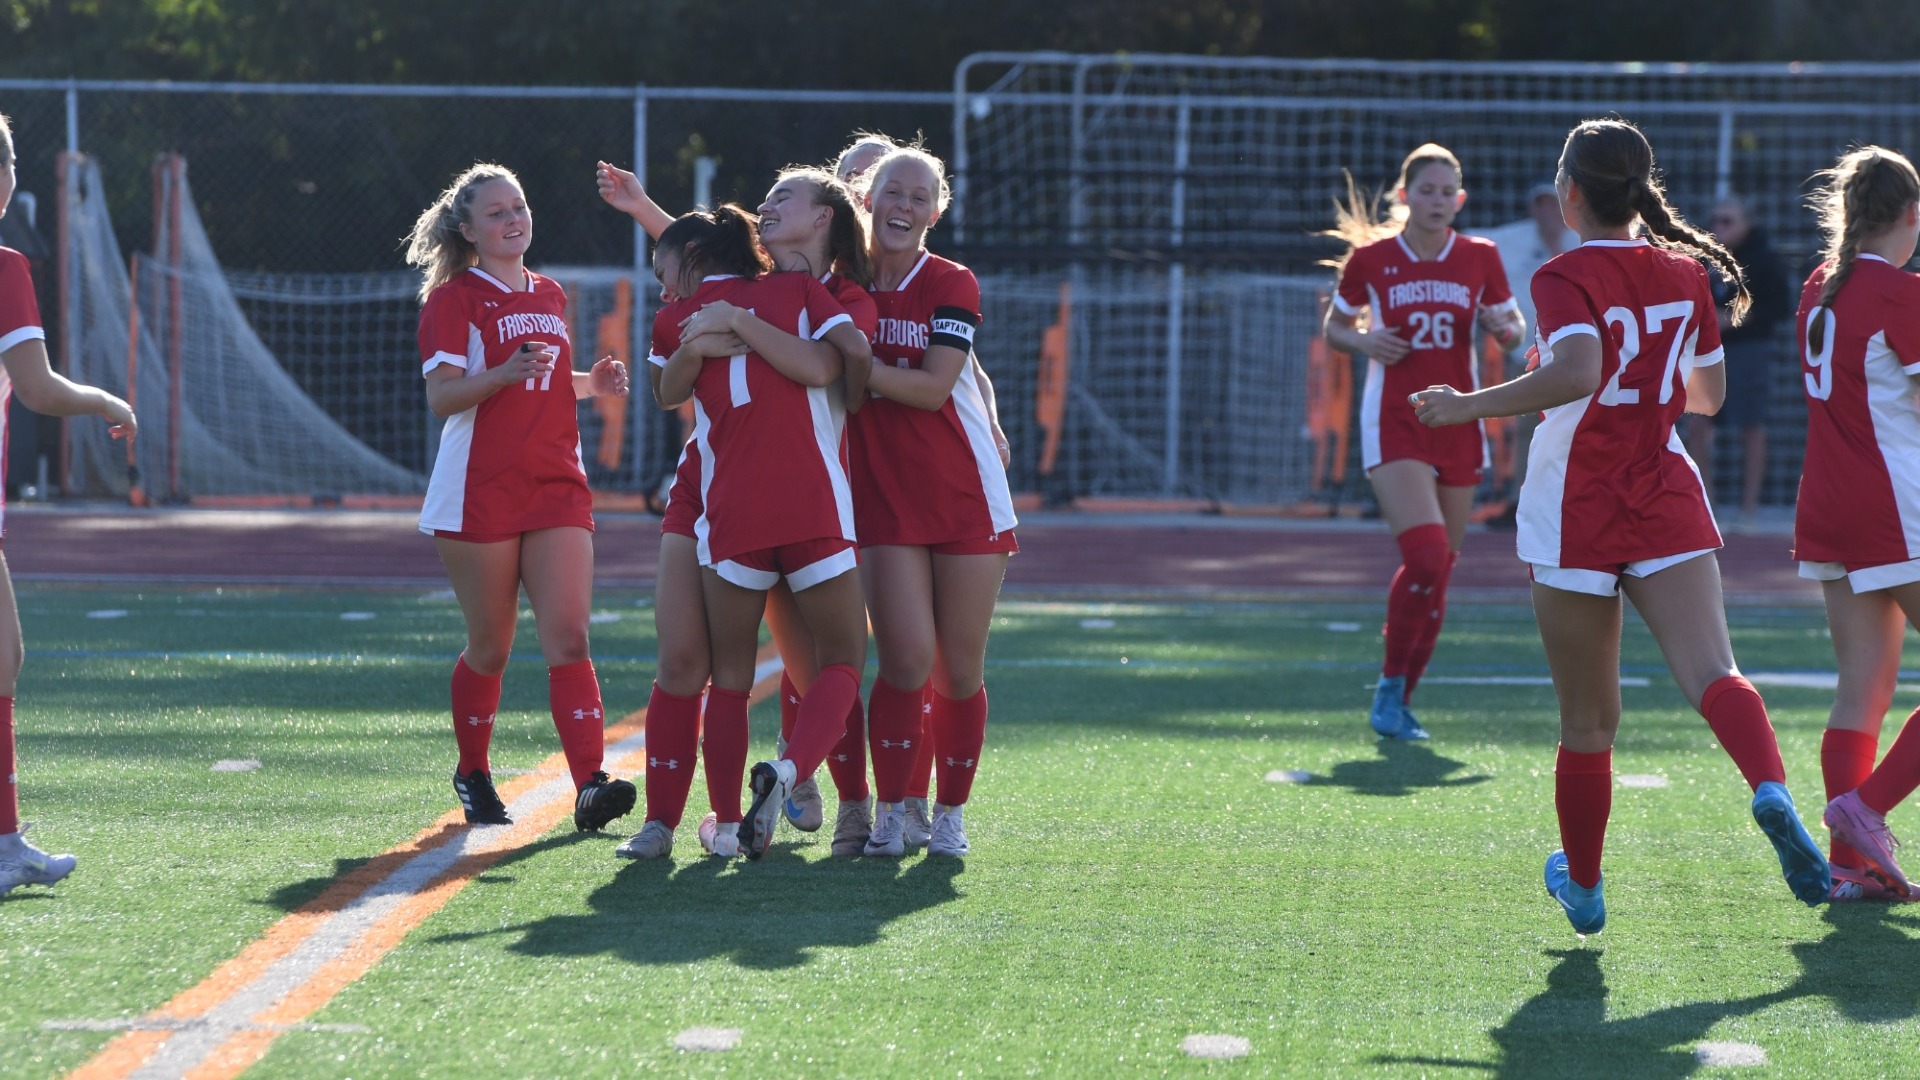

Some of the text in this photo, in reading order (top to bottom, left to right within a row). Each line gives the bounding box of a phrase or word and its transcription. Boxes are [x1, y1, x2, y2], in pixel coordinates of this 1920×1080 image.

[1388, 280, 1470, 310] FROSTBURG
[496, 313, 569, 344] FROSTBUR
[872, 318, 929, 350] TBURG
[935, 321, 969, 336] CAPTAIN
[1408, 311, 1454, 349] 26
[1598, 300, 1694, 407] 27
[1804, 306, 1836, 401] 9
